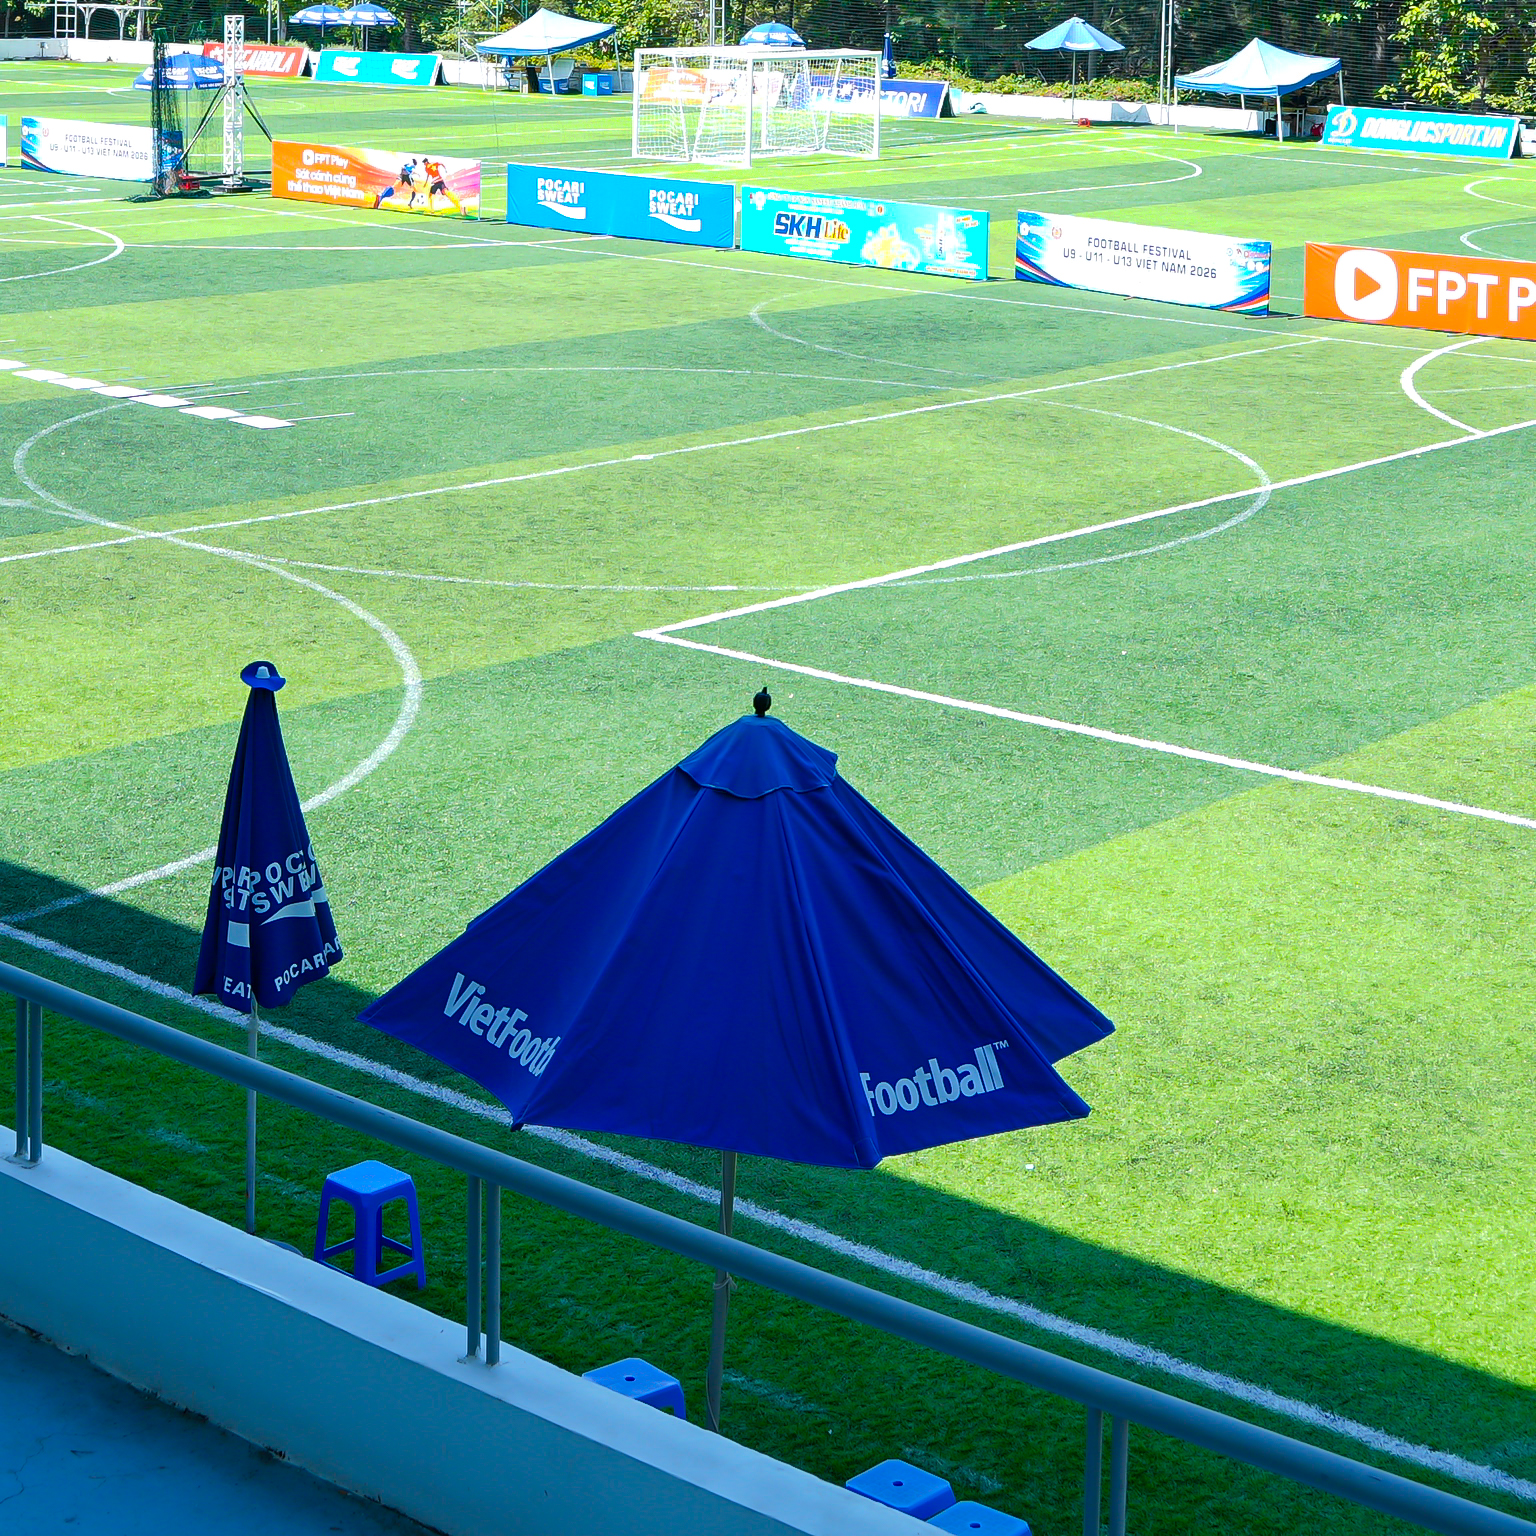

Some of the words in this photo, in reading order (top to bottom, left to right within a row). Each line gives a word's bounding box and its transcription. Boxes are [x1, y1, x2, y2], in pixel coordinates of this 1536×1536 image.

[65, 134, 98, 145] FOOTBALL
[100, 137, 132, 148] FESTIVAL
[1360, 117, 1508, 148] DONGLUCSPORT.VN
[64, 144, 76, 153] U11
[82, 147, 94, 155] U13
[113, 150, 129, 158] NAM
[131, 152, 148, 161] 2026
[314, 153, 330, 165] FPT
[331, 154, 349, 169] Play
[302, 182, 324, 194] thao
[341, 187, 364, 199] Nam
[537, 178, 585, 194] POCARI
[537, 189, 580, 204] SWEAT
[649, 189, 699, 206] POCARI
[649, 201, 695, 217] SWEAT
[775, 213, 822, 239] SKH
[824, 220, 849, 240] Life
[1088, 237, 1139, 254] FOOTBALL
[1143, 244, 1192, 261] FESTIVAL
[1063, 248, 1076, 259] U9
[1085, 251, 1103, 263] U11
[1114, 254, 1132, 267] U13
[1162, 261, 1186, 274] NAM
[1190, 265, 1217, 279] 2026
[1407, 267, 1499, 319] FPT
